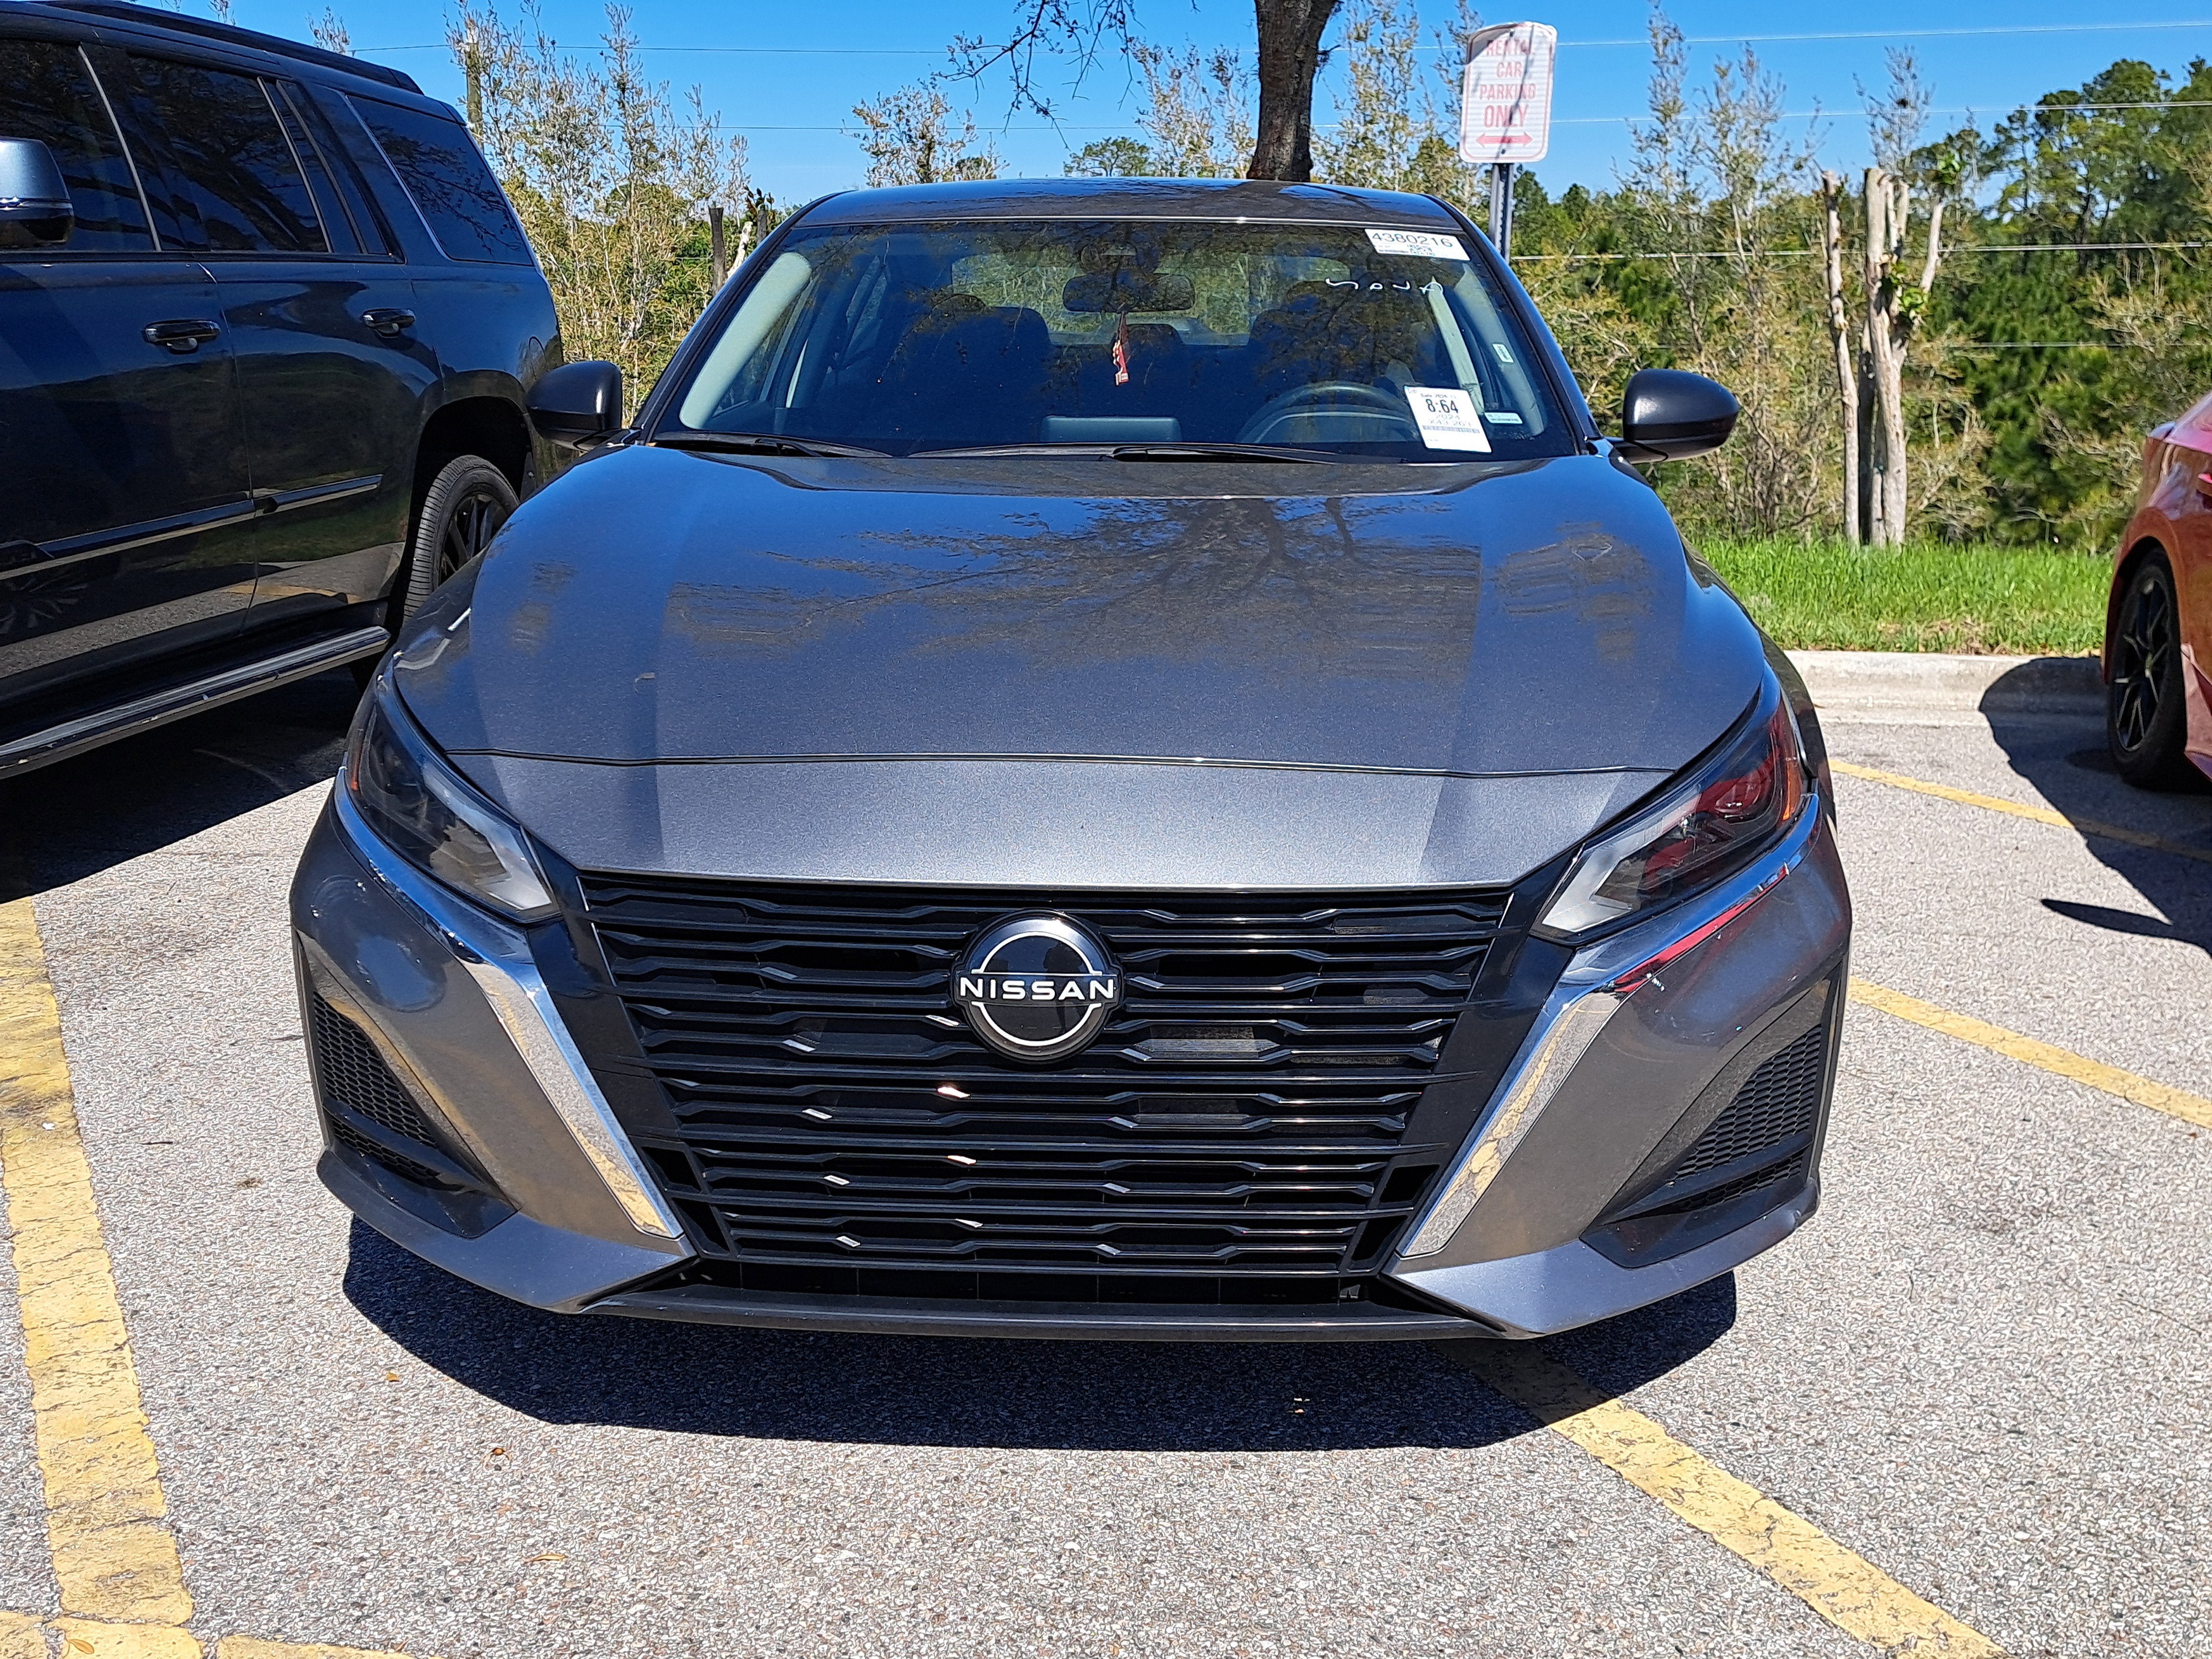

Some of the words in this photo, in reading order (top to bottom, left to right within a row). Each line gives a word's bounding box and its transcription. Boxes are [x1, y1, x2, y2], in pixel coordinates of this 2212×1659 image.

[1497, 61, 1523, 78] CAR
[1480, 83, 1536, 100] PARKING
[1484, 104, 1529, 128] ONLY
[1372, 232, 1453, 247] 4380216
[1426, 398, 1459, 414] 8:64
[960, 977, 1114, 1000] NISSAN
